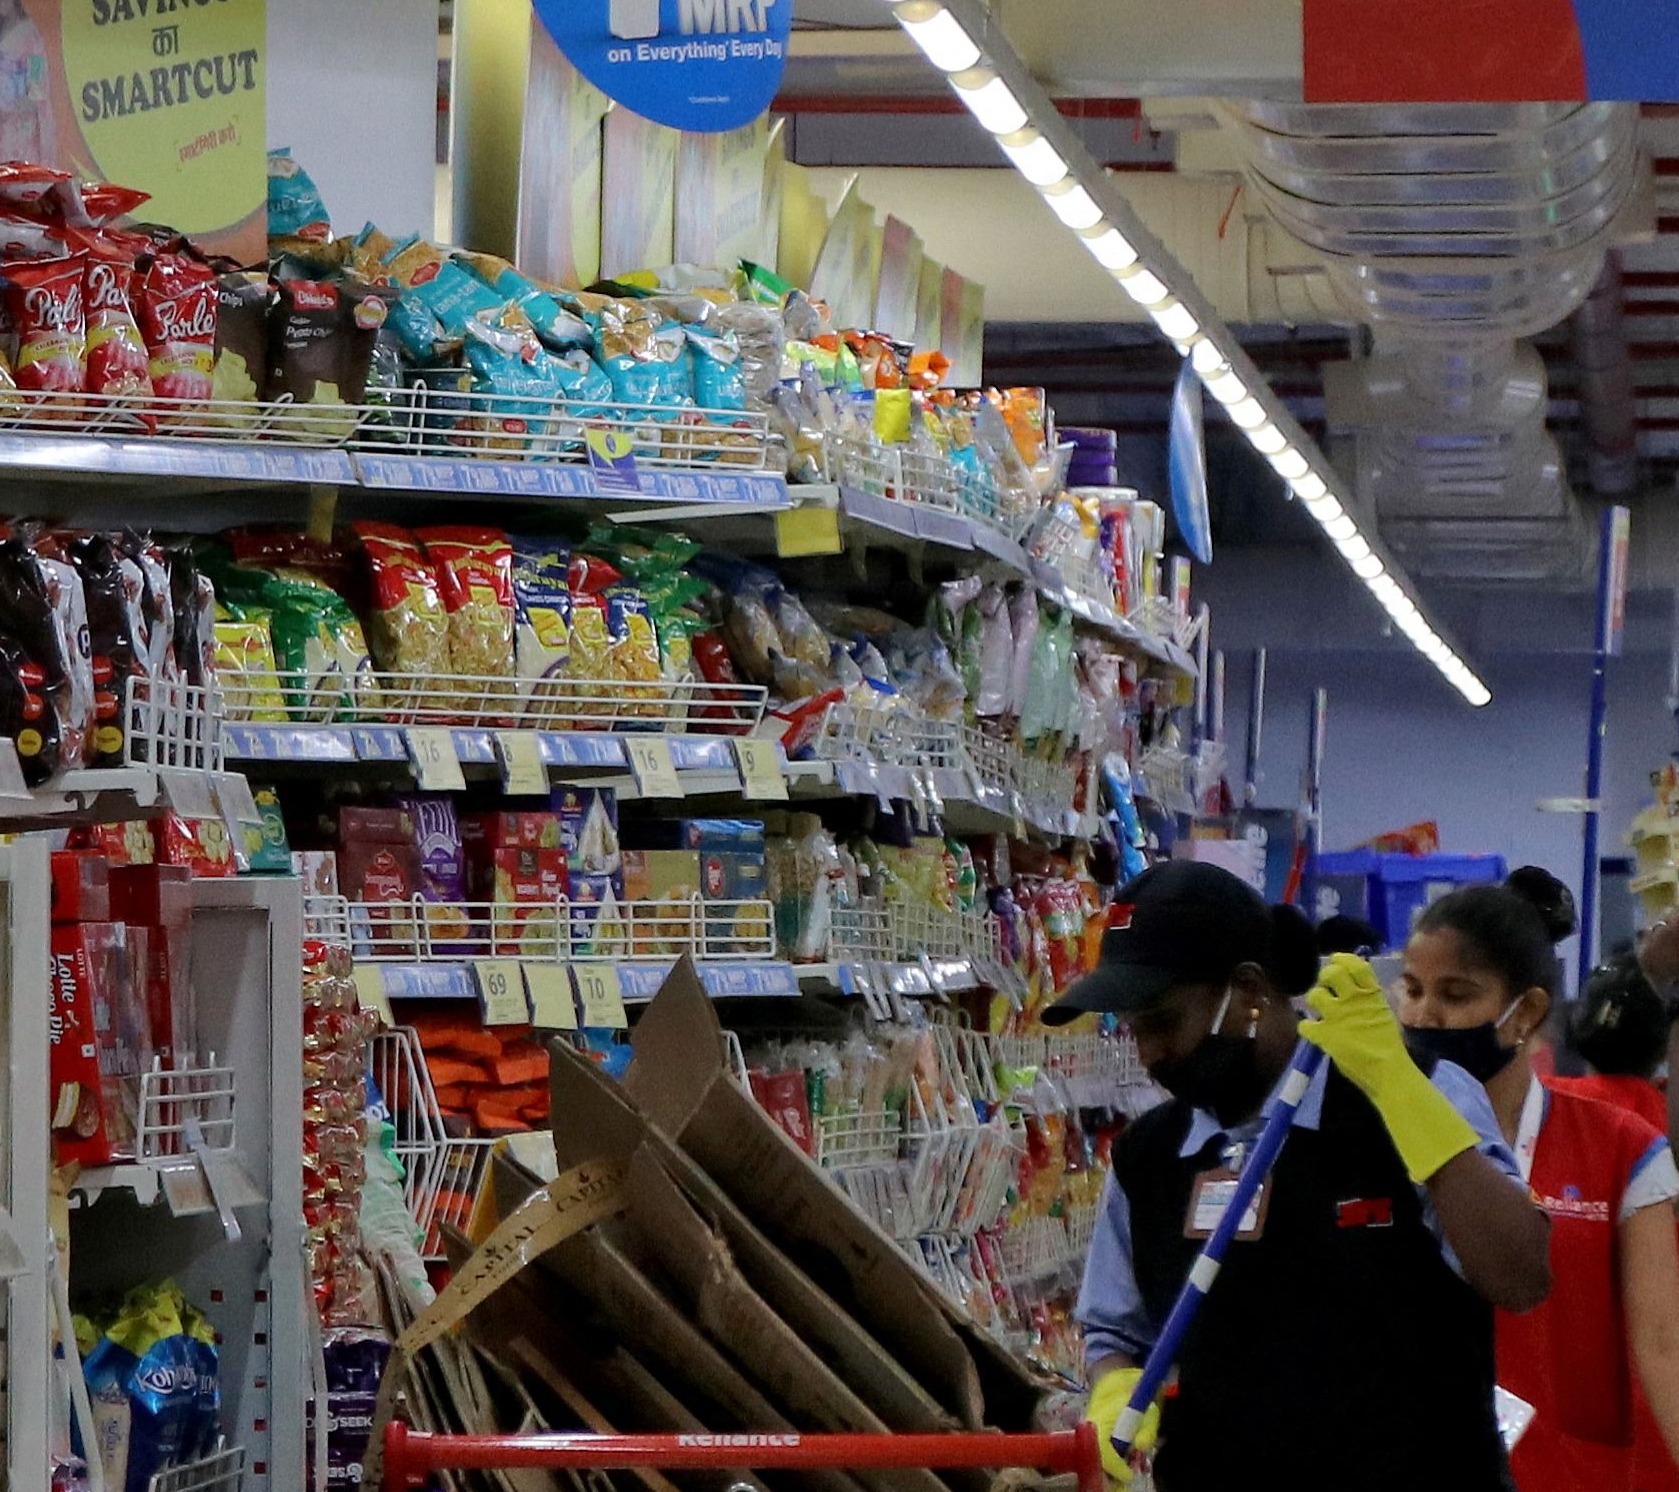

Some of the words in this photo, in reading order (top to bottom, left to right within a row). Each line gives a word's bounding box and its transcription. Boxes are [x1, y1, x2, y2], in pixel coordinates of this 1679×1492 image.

[151, 24, 180, 58] का
[607, 48, 632, 64] on
[731, 40, 764, 60] Every
[81, 48, 259, 124] SMARTCUT
[56, 953, 77, 1004] Lotte
[487, 975, 508, 996] 69
[587, 977, 607, 1000] 10
